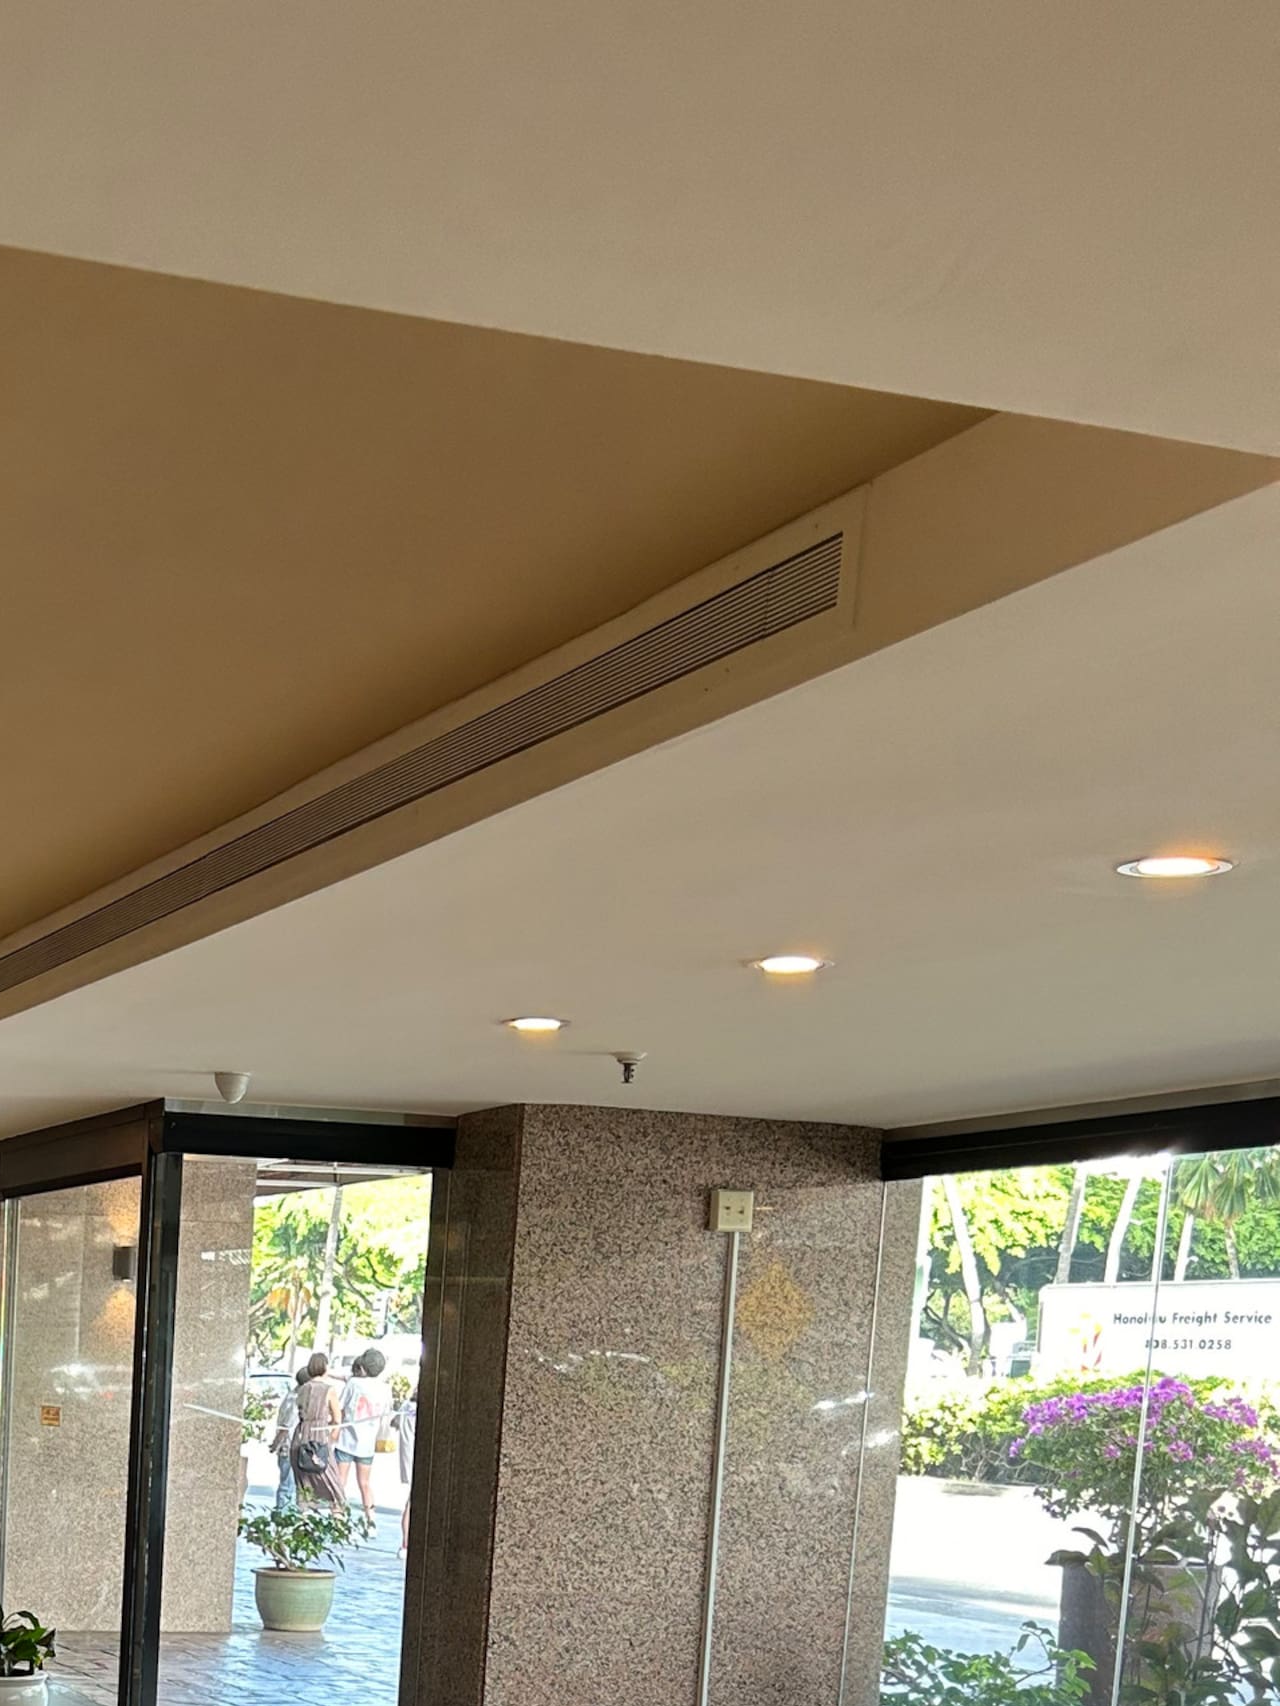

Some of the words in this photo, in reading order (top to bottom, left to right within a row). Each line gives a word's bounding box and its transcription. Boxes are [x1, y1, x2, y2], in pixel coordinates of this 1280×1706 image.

[1113, 1312, 1167, 1325] Honolu
[1172, 1311, 1218, 1327] Freight
[1224, 1310, 1273, 1325] Service
